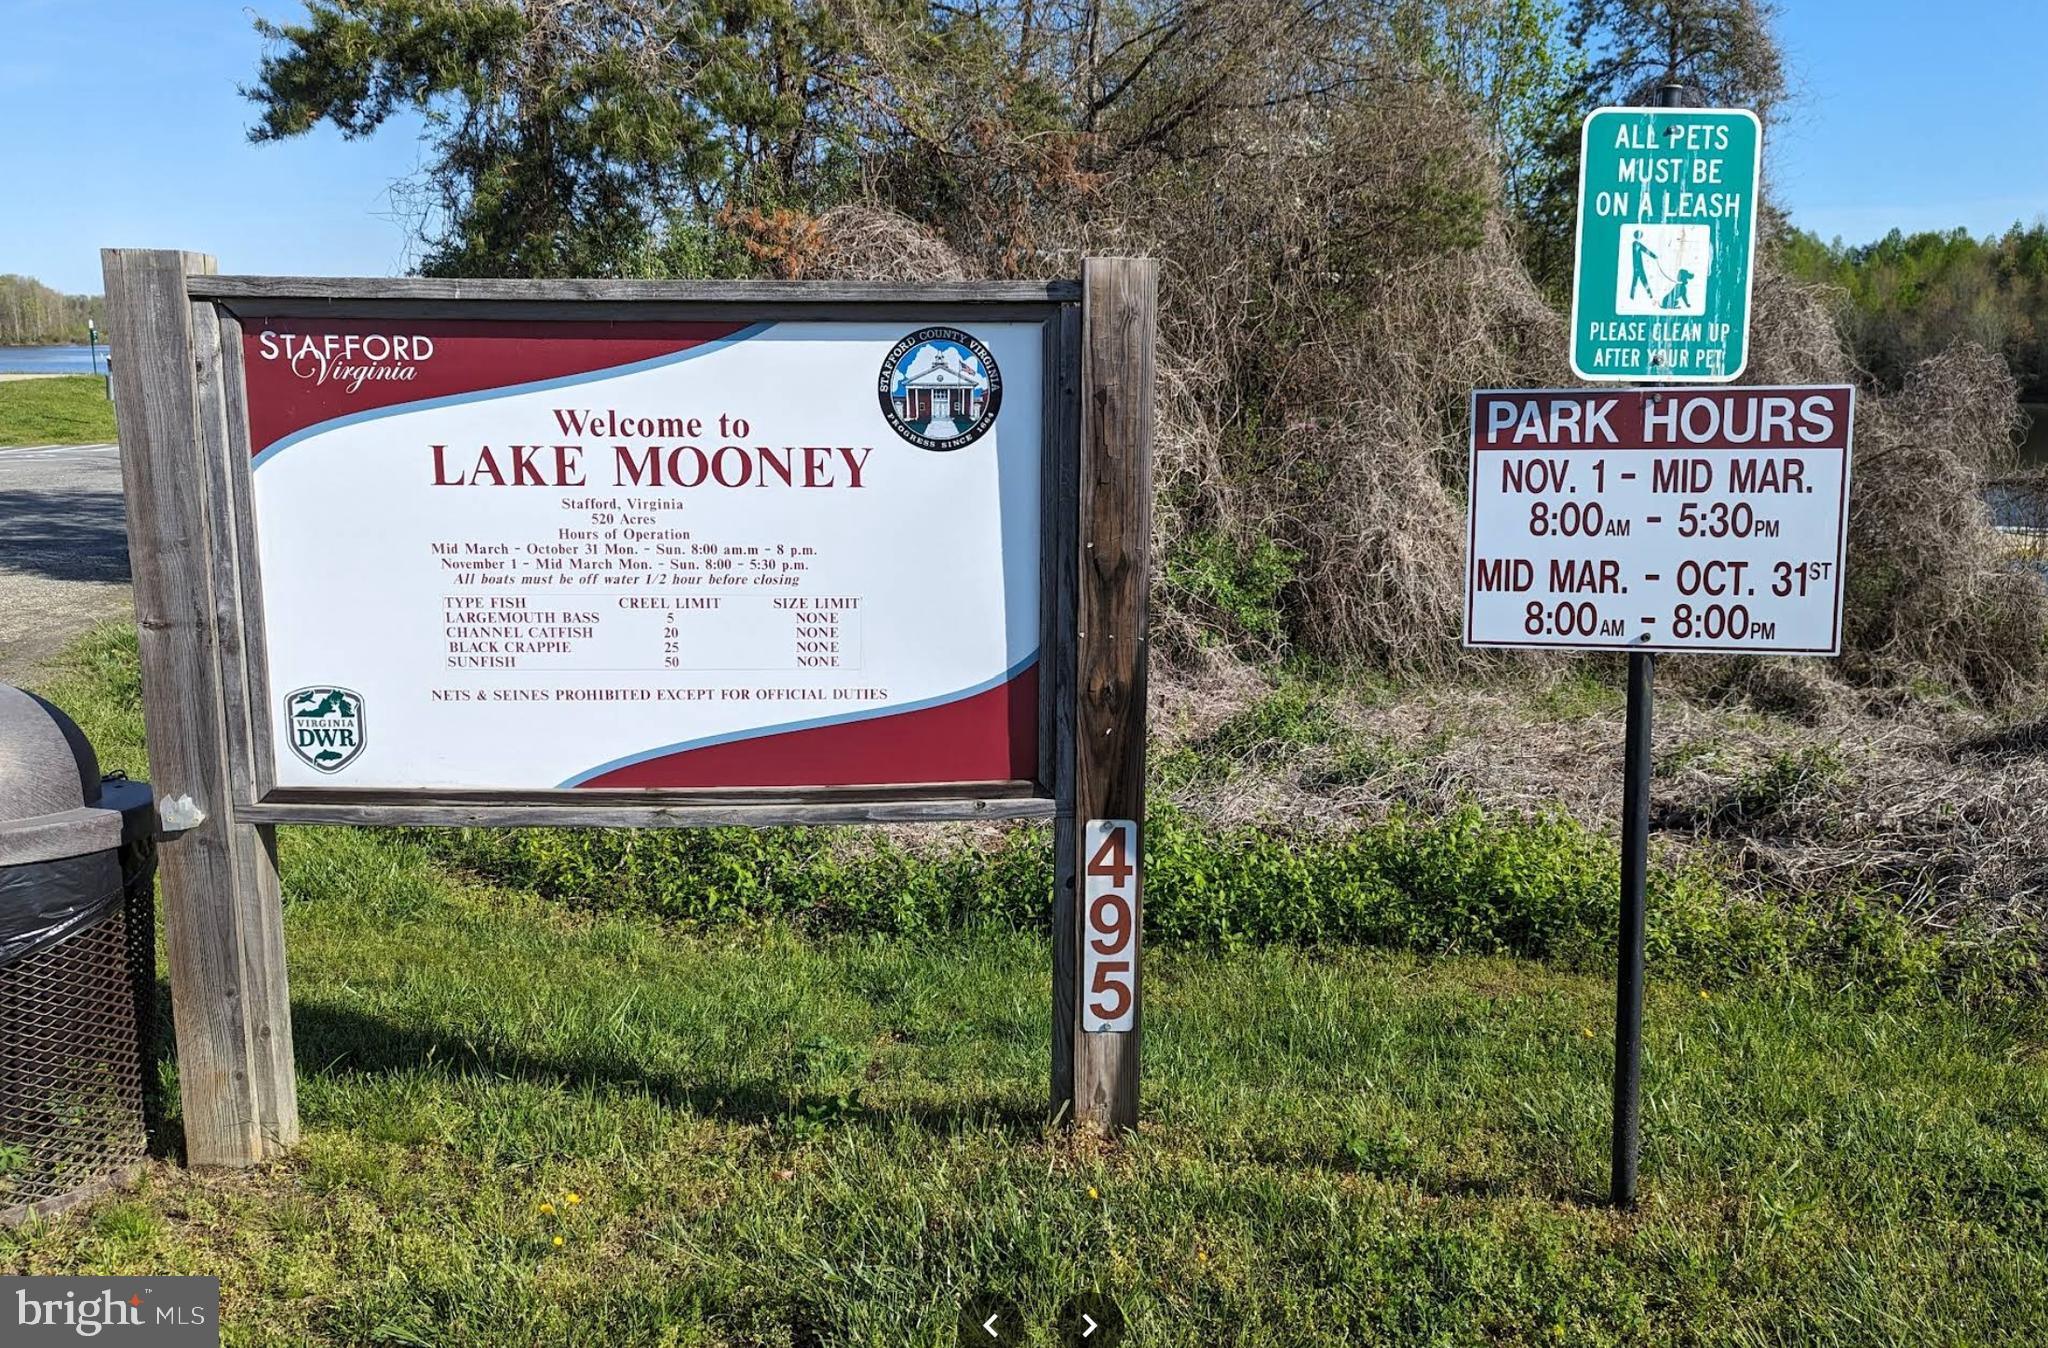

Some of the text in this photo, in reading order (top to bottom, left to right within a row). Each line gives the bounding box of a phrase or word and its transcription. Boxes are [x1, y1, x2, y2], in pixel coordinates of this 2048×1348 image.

[1614, 124, 1730, 150] ALL PETS
[1618, 158, 1724, 184] MUST BE
[1595, 191, 1741, 218] ON A LEASH
[1590, 322, 1731, 342] PLEASE CLEAN UP
[259, 331, 434, 361] STAFFORD
[879, 329, 1001, 393] STAFFORD COUNTY VIRGINIA
[1593, 349, 1640, 368] AFTER
[1695, 349, 1725, 368] PET
[291, 350, 418, 394] Virginia
[552, 409, 750, 439] Welcome to
[1487, 396, 1834, 445] PARK HOURS
[887, 412, 937, 448] PROGRESS
[940, 432, 974, 449] SINCE
[430, 444, 874, 488] LAKE MOONEY
[1501, 458, 1813, 495] NOV. 1 - MID MAR.
[561, 497, 684, 512] Stafford, Virginia
[591, 512, 656, 525] 520 Acres
[1529, 501, 1780, 539] 8:00AM - 5:30PM
[558, 528, 690, 543] Hours of Operation
[431, 542, 459, 555] Mid
[465, 542, 509, 555] March
[526, 543, 579, 555] October
[584, 542, 598, 555] 31
[605, 543, 638, 555] Mon.
[656, 543, 686, 555] Sun.
[691, 543, 718, 555] 8:00
[723, 546, 759, 556] am.m
[776, 543, 785, 555] 8
[790, 547, 817, 558] p.m.
[441, 557, 505, 570] November
[511, 558, 517, 570] 1
[535, 557, 563, 570] Mid
[569, 558, 613, 570] March
[618, 558, 653, 570] Mon.
[669, 558, 700, 571] Sun.
[704, 558, 732, 570] 8:00
[749, 558, 776, 571] 5:30
[782, 561, 809, 573] p.m.
[453, 572, 800, 587] All boats must be off water 1/2 hour before closing
[1476, 559, 1833, 598] MID MAR. - OCT. 31ST
[444, 596, 526, 609] TYPE FISH
[618, 597, 721, 609] CREEL LIMIT
[773, 597, 860, 609] SIZE LIMIT
[445, 611, 600, 624] LARGEMOUTH BASS
[666, 612, 675, 624] 5
[796, 612, 839, 624] NONE
[1524, 601, 1625, 637] 8:00AM
[1672, 603, 1776, 641] 8:00PM
[446, 626, 593, 639] CHANNEL CATFISH
[663, 626, 679, 639] 20
[796, 626, 839, 639] NONE
[449, 641, 572, 653] BLACK CRAPPIE
[664, 641, 680, 653] 25
[796, 641, 839, 653] NONE
[447, 656, 516, 668] SUNFISH
[664, 656, 680, 668] 50
[797, 655, 840, 667] NONE
[431, 688, 888, 701] NETS & SEINES PROHIBITED EXCEPT FOR OFFICIAL DUTIES
[296, 719, 355, 728] VIRGINIA
[296, 728, 357, 747] DWR
[1087, 827, 1134, 1020] 495
